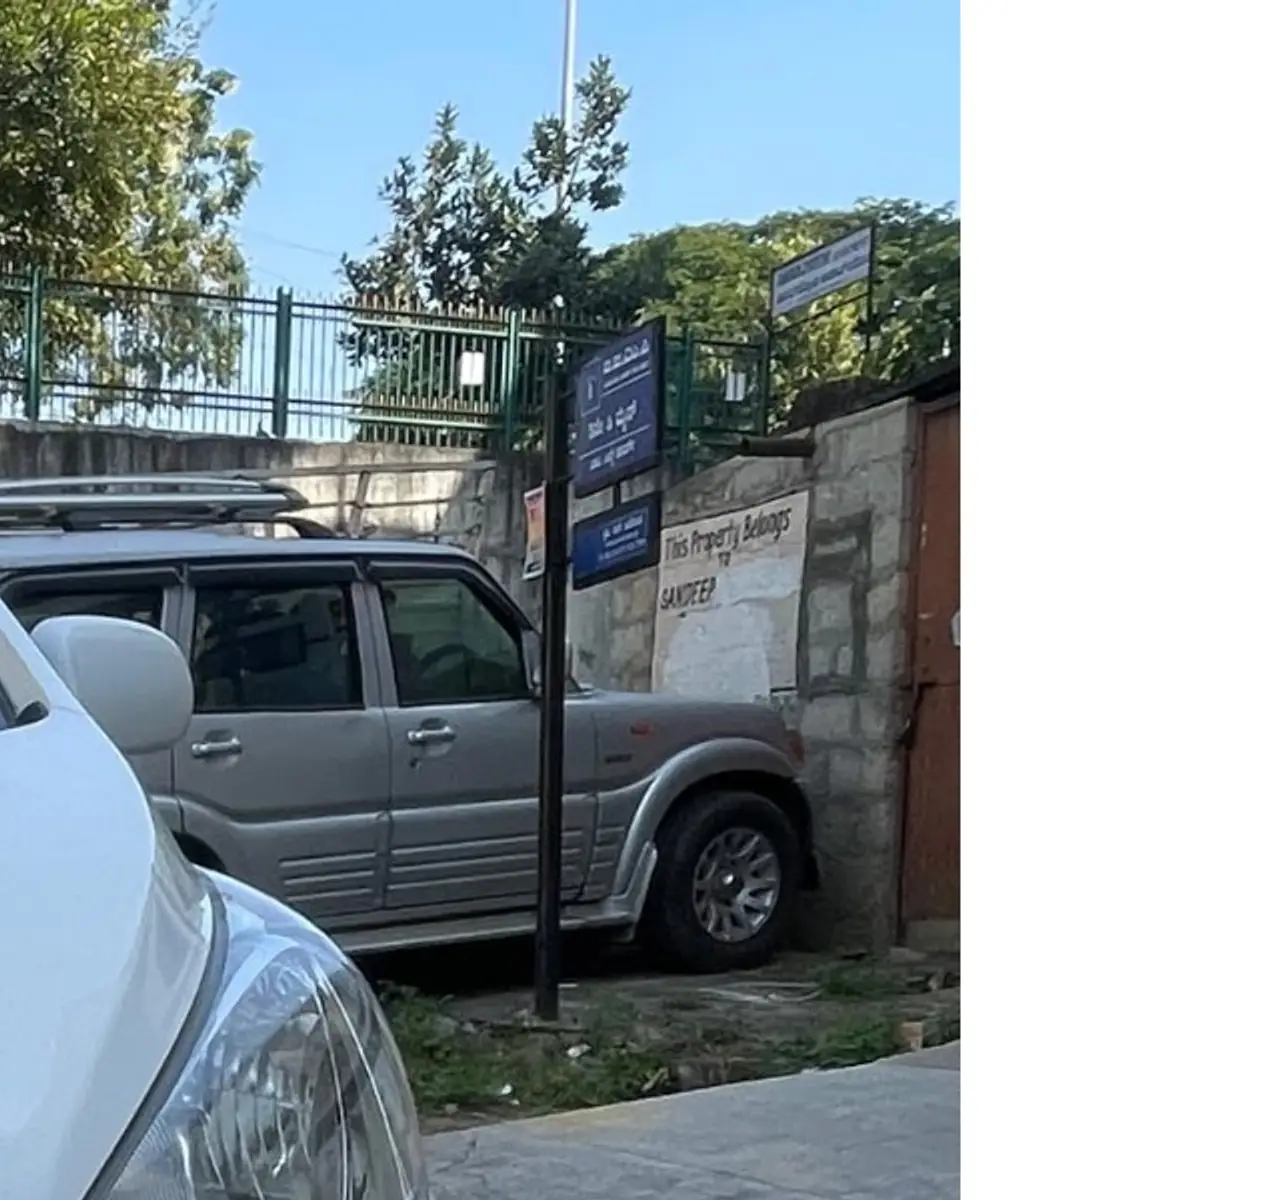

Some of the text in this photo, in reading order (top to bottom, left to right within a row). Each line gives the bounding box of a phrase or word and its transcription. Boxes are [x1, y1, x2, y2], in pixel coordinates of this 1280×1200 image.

[665, 532, 689, 560] This
[691, 518, 740, 558] Property
[743, 508, 792, 543] Belongs
